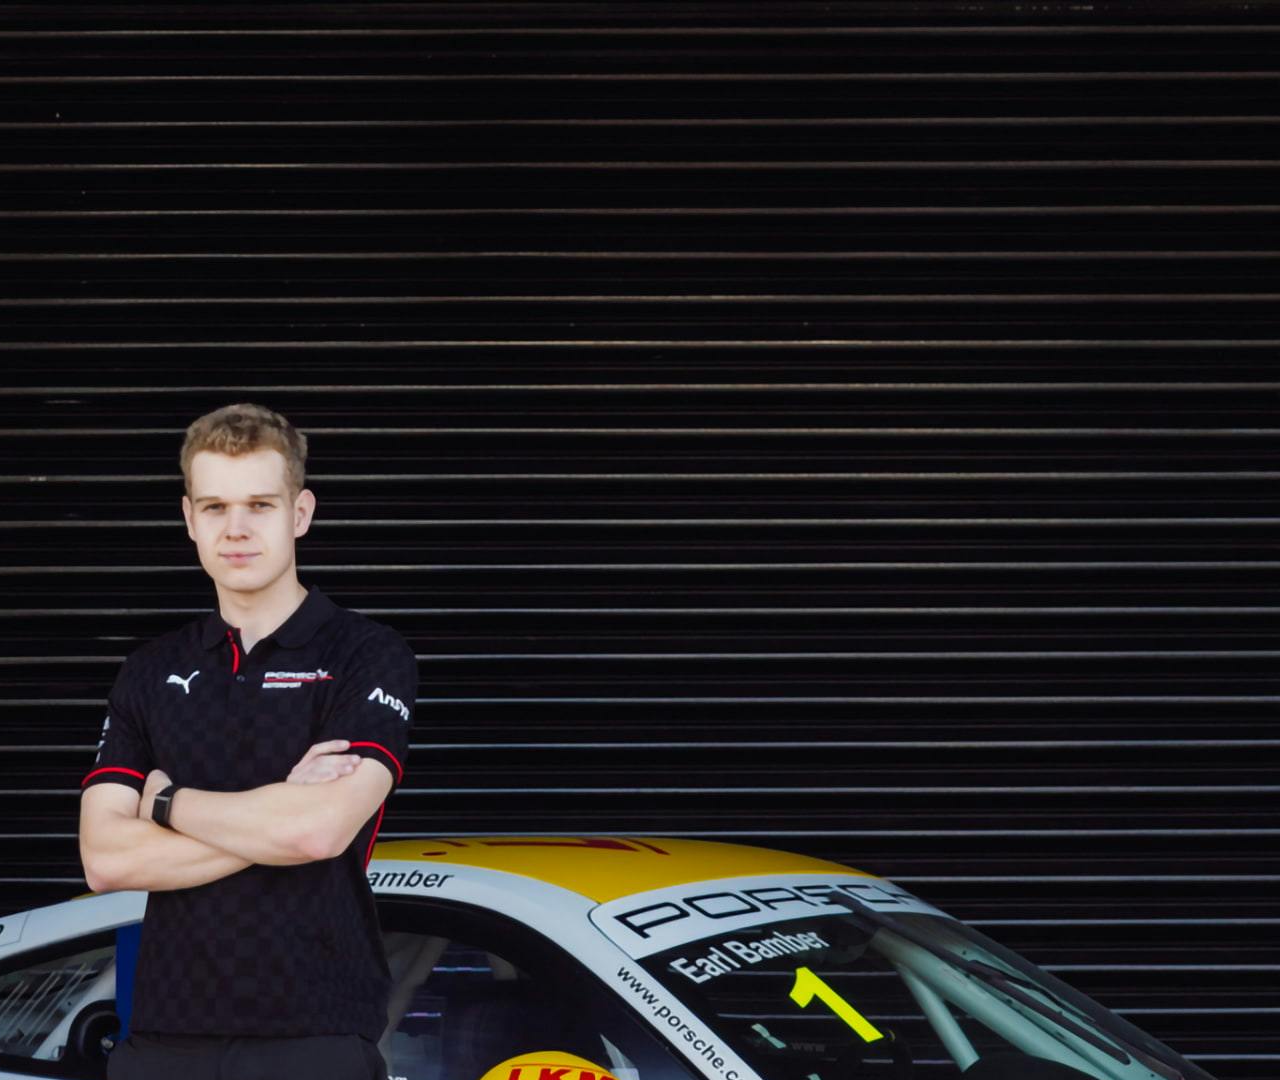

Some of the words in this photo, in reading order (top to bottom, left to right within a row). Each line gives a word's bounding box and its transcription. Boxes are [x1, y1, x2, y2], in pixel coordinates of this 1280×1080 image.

[368, 869, 455, 889] amber
[669, 946, 742, 984] Earl
[723, 931, 831, 964] Bamber
[789, 966, 885, 1043] 1
